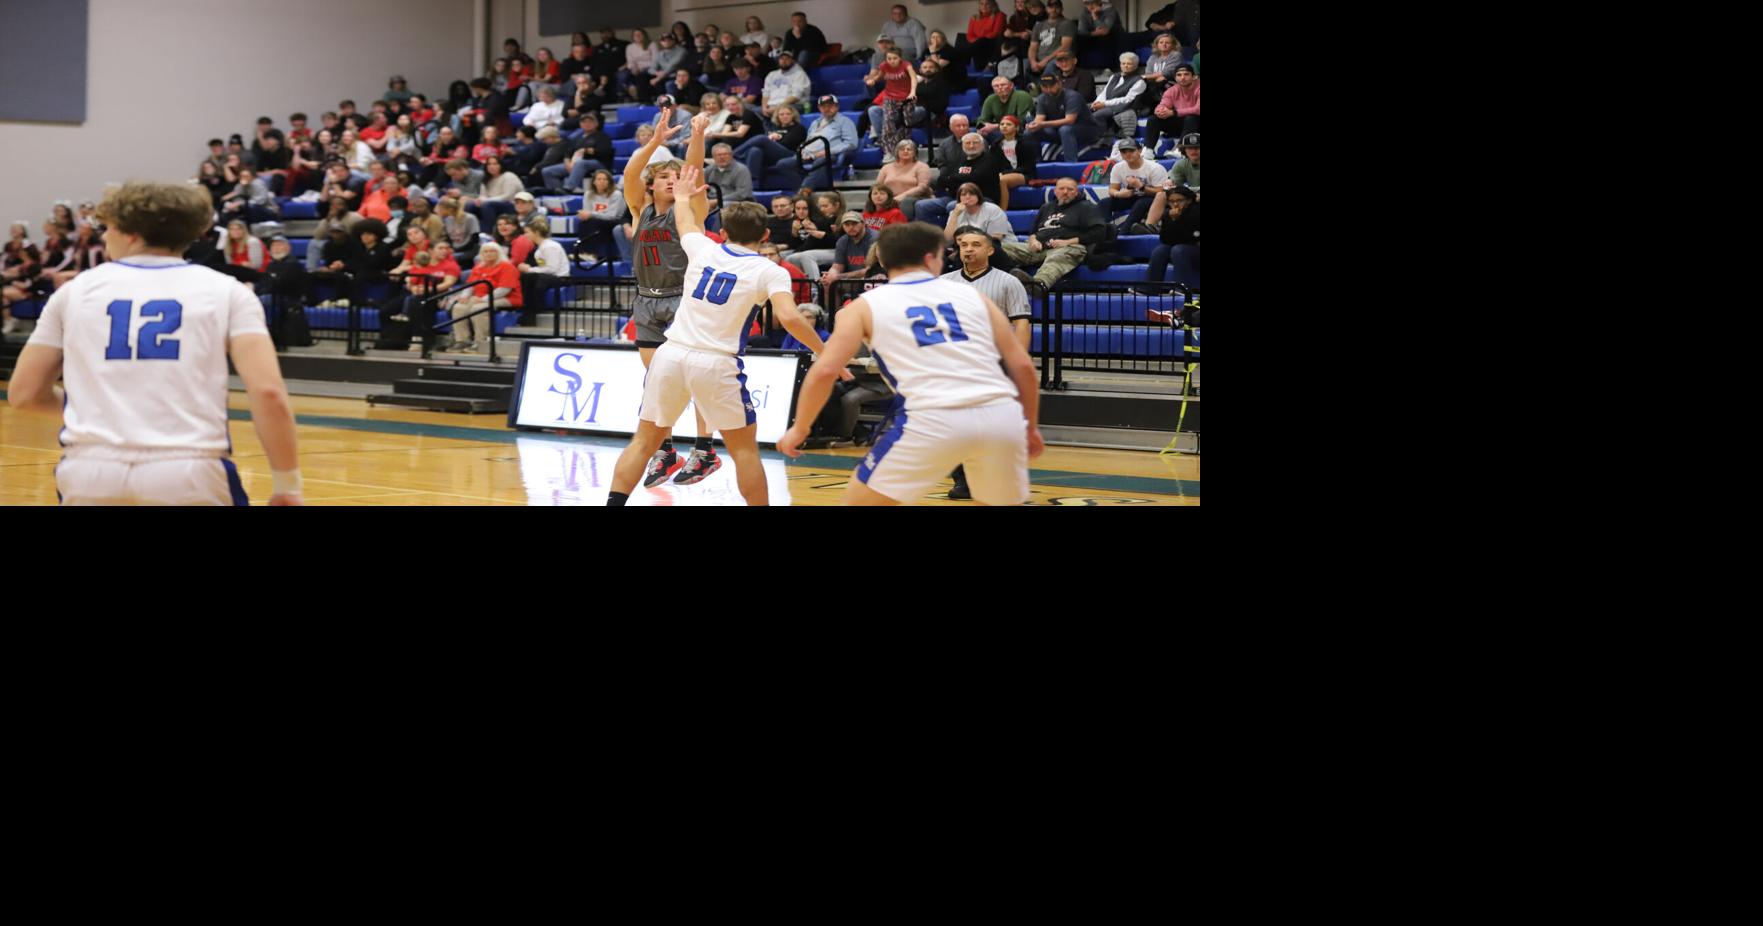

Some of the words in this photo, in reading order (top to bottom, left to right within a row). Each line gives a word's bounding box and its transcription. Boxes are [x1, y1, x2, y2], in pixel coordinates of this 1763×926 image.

[643, 245, 661, 266] 11
[691, 266, 738, 305] 10
[105, 299, 183, 360] 12
[905, 302, 969, 347] 21
